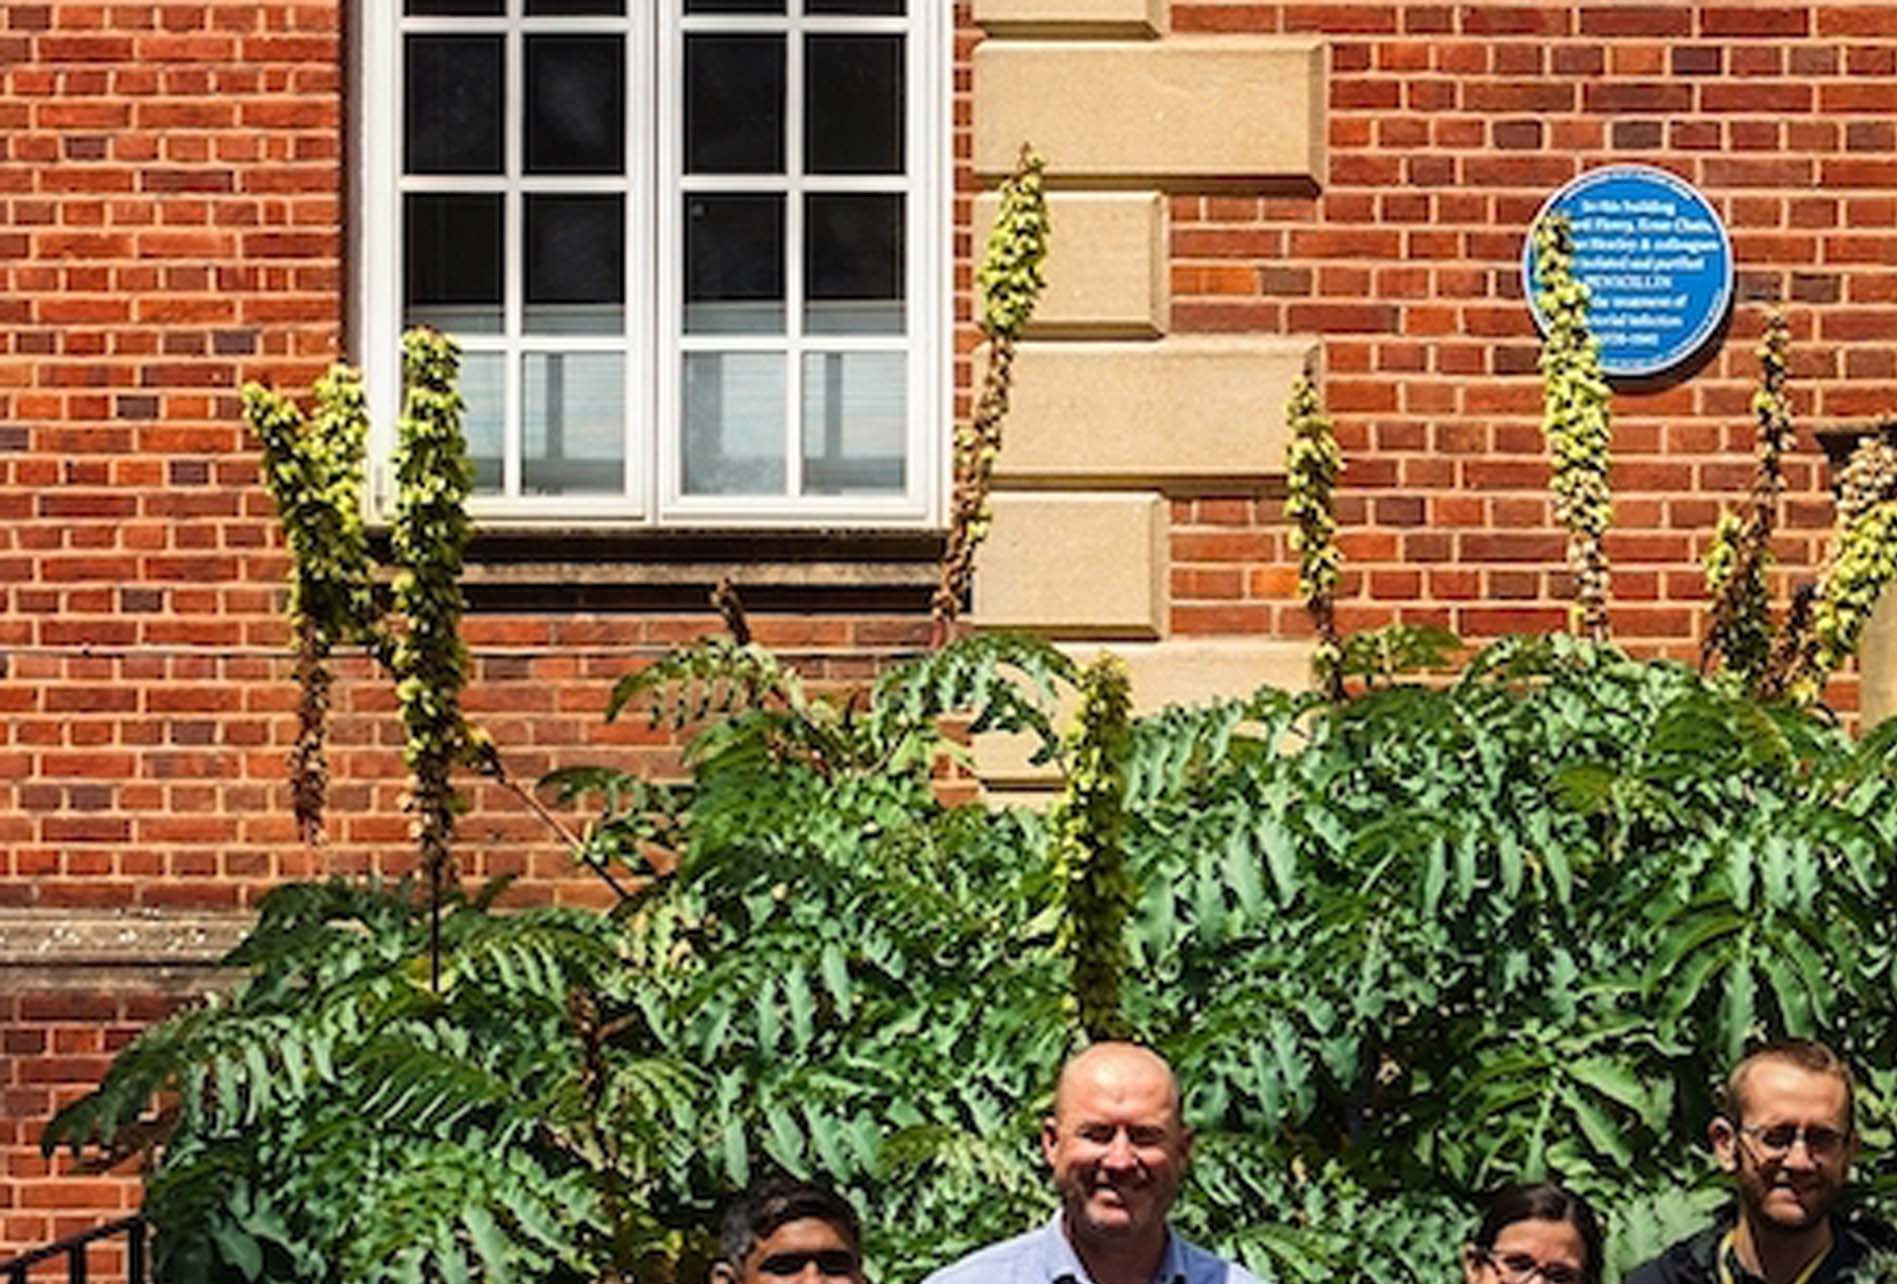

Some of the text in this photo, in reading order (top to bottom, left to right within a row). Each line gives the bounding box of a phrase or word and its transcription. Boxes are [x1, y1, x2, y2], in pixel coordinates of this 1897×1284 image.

[1622, 201, 1676, 215] building
[1640, 238, 1650, 250] &
[1654, 238, 1720, 254] colleagues
[1629, 256, 1653, 269] and
[1653, 256, 1704, 271] purified
[1673, 294, 1688, 308] of
